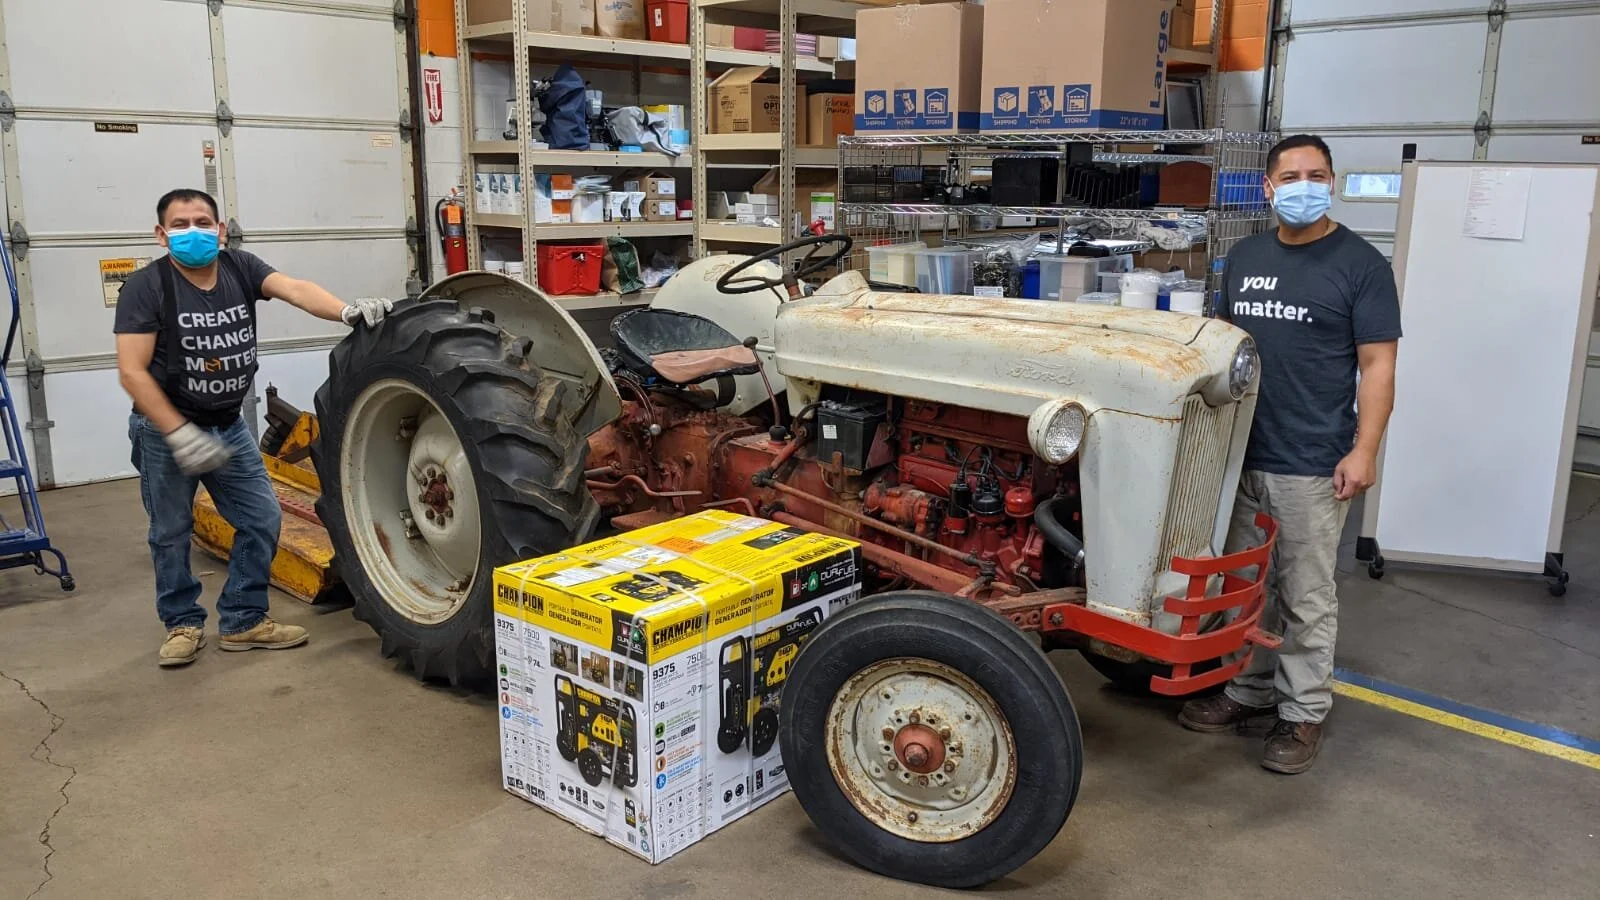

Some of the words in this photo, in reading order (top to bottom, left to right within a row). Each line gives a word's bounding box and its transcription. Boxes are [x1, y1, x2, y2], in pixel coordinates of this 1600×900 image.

[1150, 10, 1169, 108] Large
[107, 124, 137, 132] Smoking
[106, 262, 134, 270] WARNING
[1239, 276, 1279, 293] you
[177, 303, 249, 328] CREATE
[1233, 300, 1313, 323] matter.
[180, 324, 255, 350] CHANGE
[1007, 359, 1077, 387] Ford
[187, 374, 250, 394] MORE.
[715, 602, 740, 617] PORTABLE
[740, 588, 774, 606] GENRATOR
[496, 618, 515, 632] 9375
[548, 610, 582, 627] GENERADOR
[570, 608, 603, 625] GENERATOR
[714, 606, 752, 625] GENERADOR
[652, 662, 676, 680] 9375
